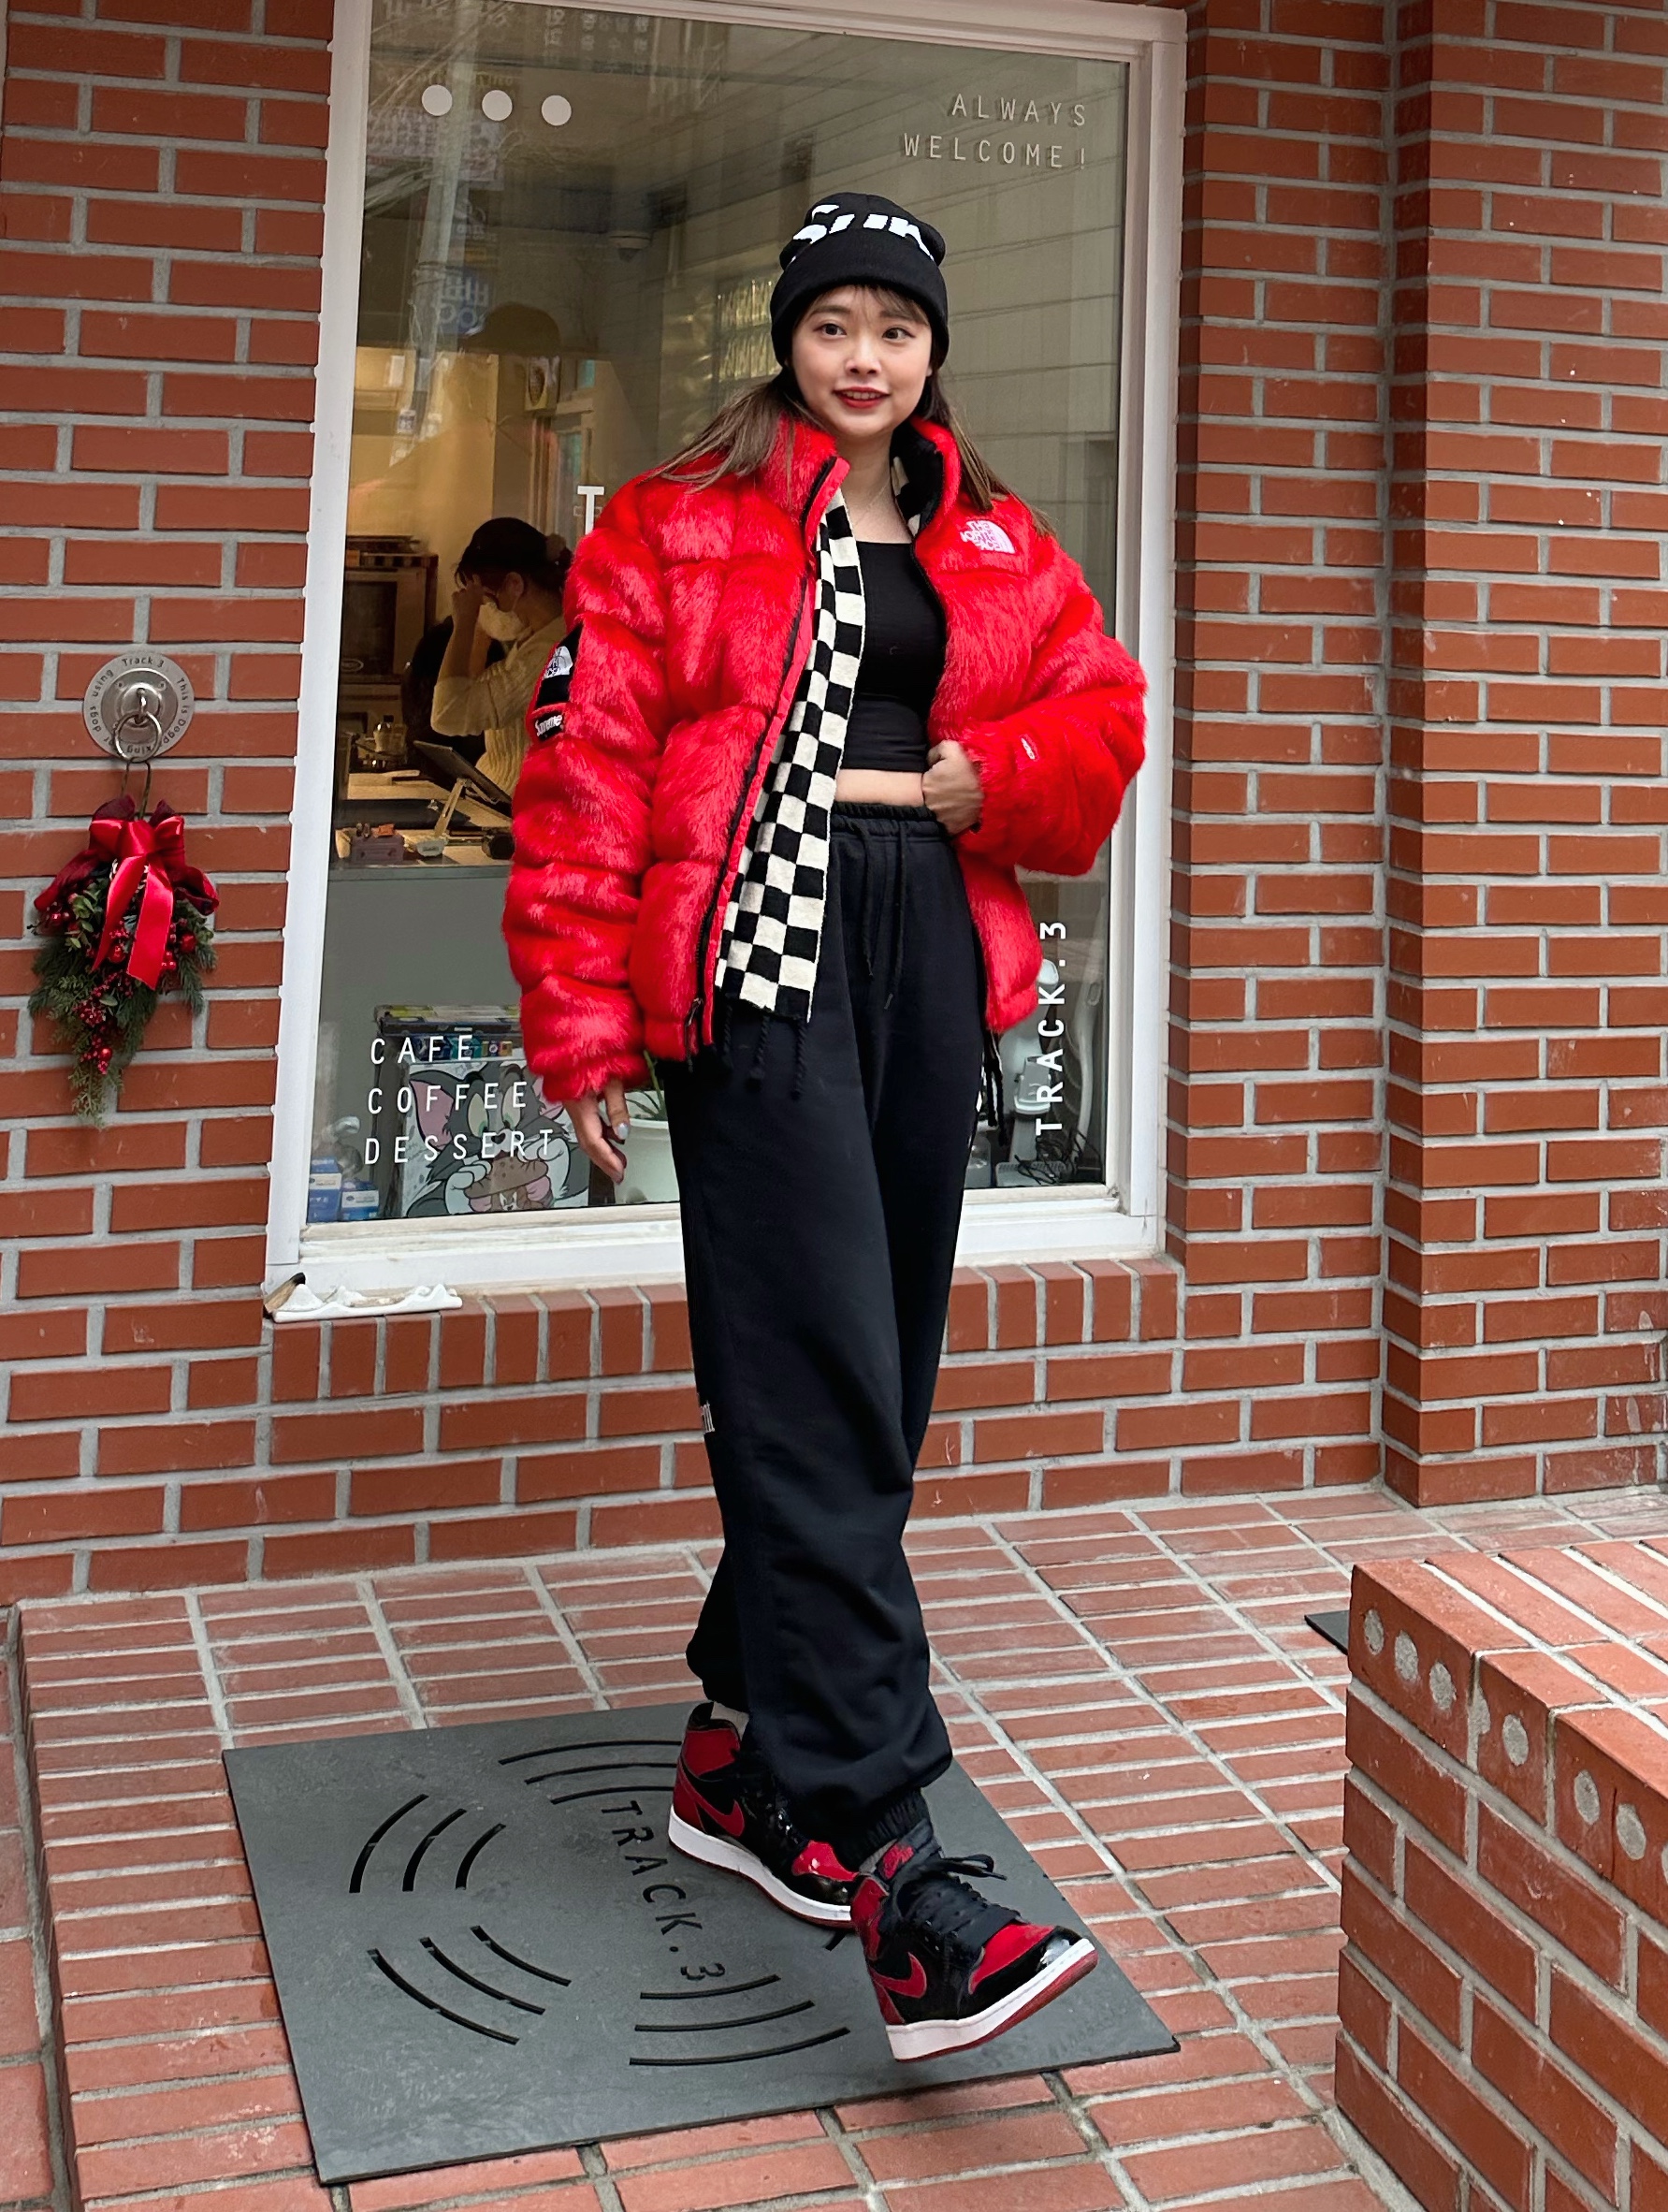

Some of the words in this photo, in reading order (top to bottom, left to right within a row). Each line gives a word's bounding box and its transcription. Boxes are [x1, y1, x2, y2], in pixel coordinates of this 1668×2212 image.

[951, 93, 1086, 126] ALWAYS
[122, 656, 153, 666] Track
[92, 669, 114, 697] using
[176, 677, 189, 701] This
[90, 706, 102, 733] dogs
[181, 705, 191, 714] is
[1036, 922, 1066, 1135] TRACK.3
[368, 1082, 528, 1115] COFFEE
[365, 1129, 554, 1165] DESSERT
